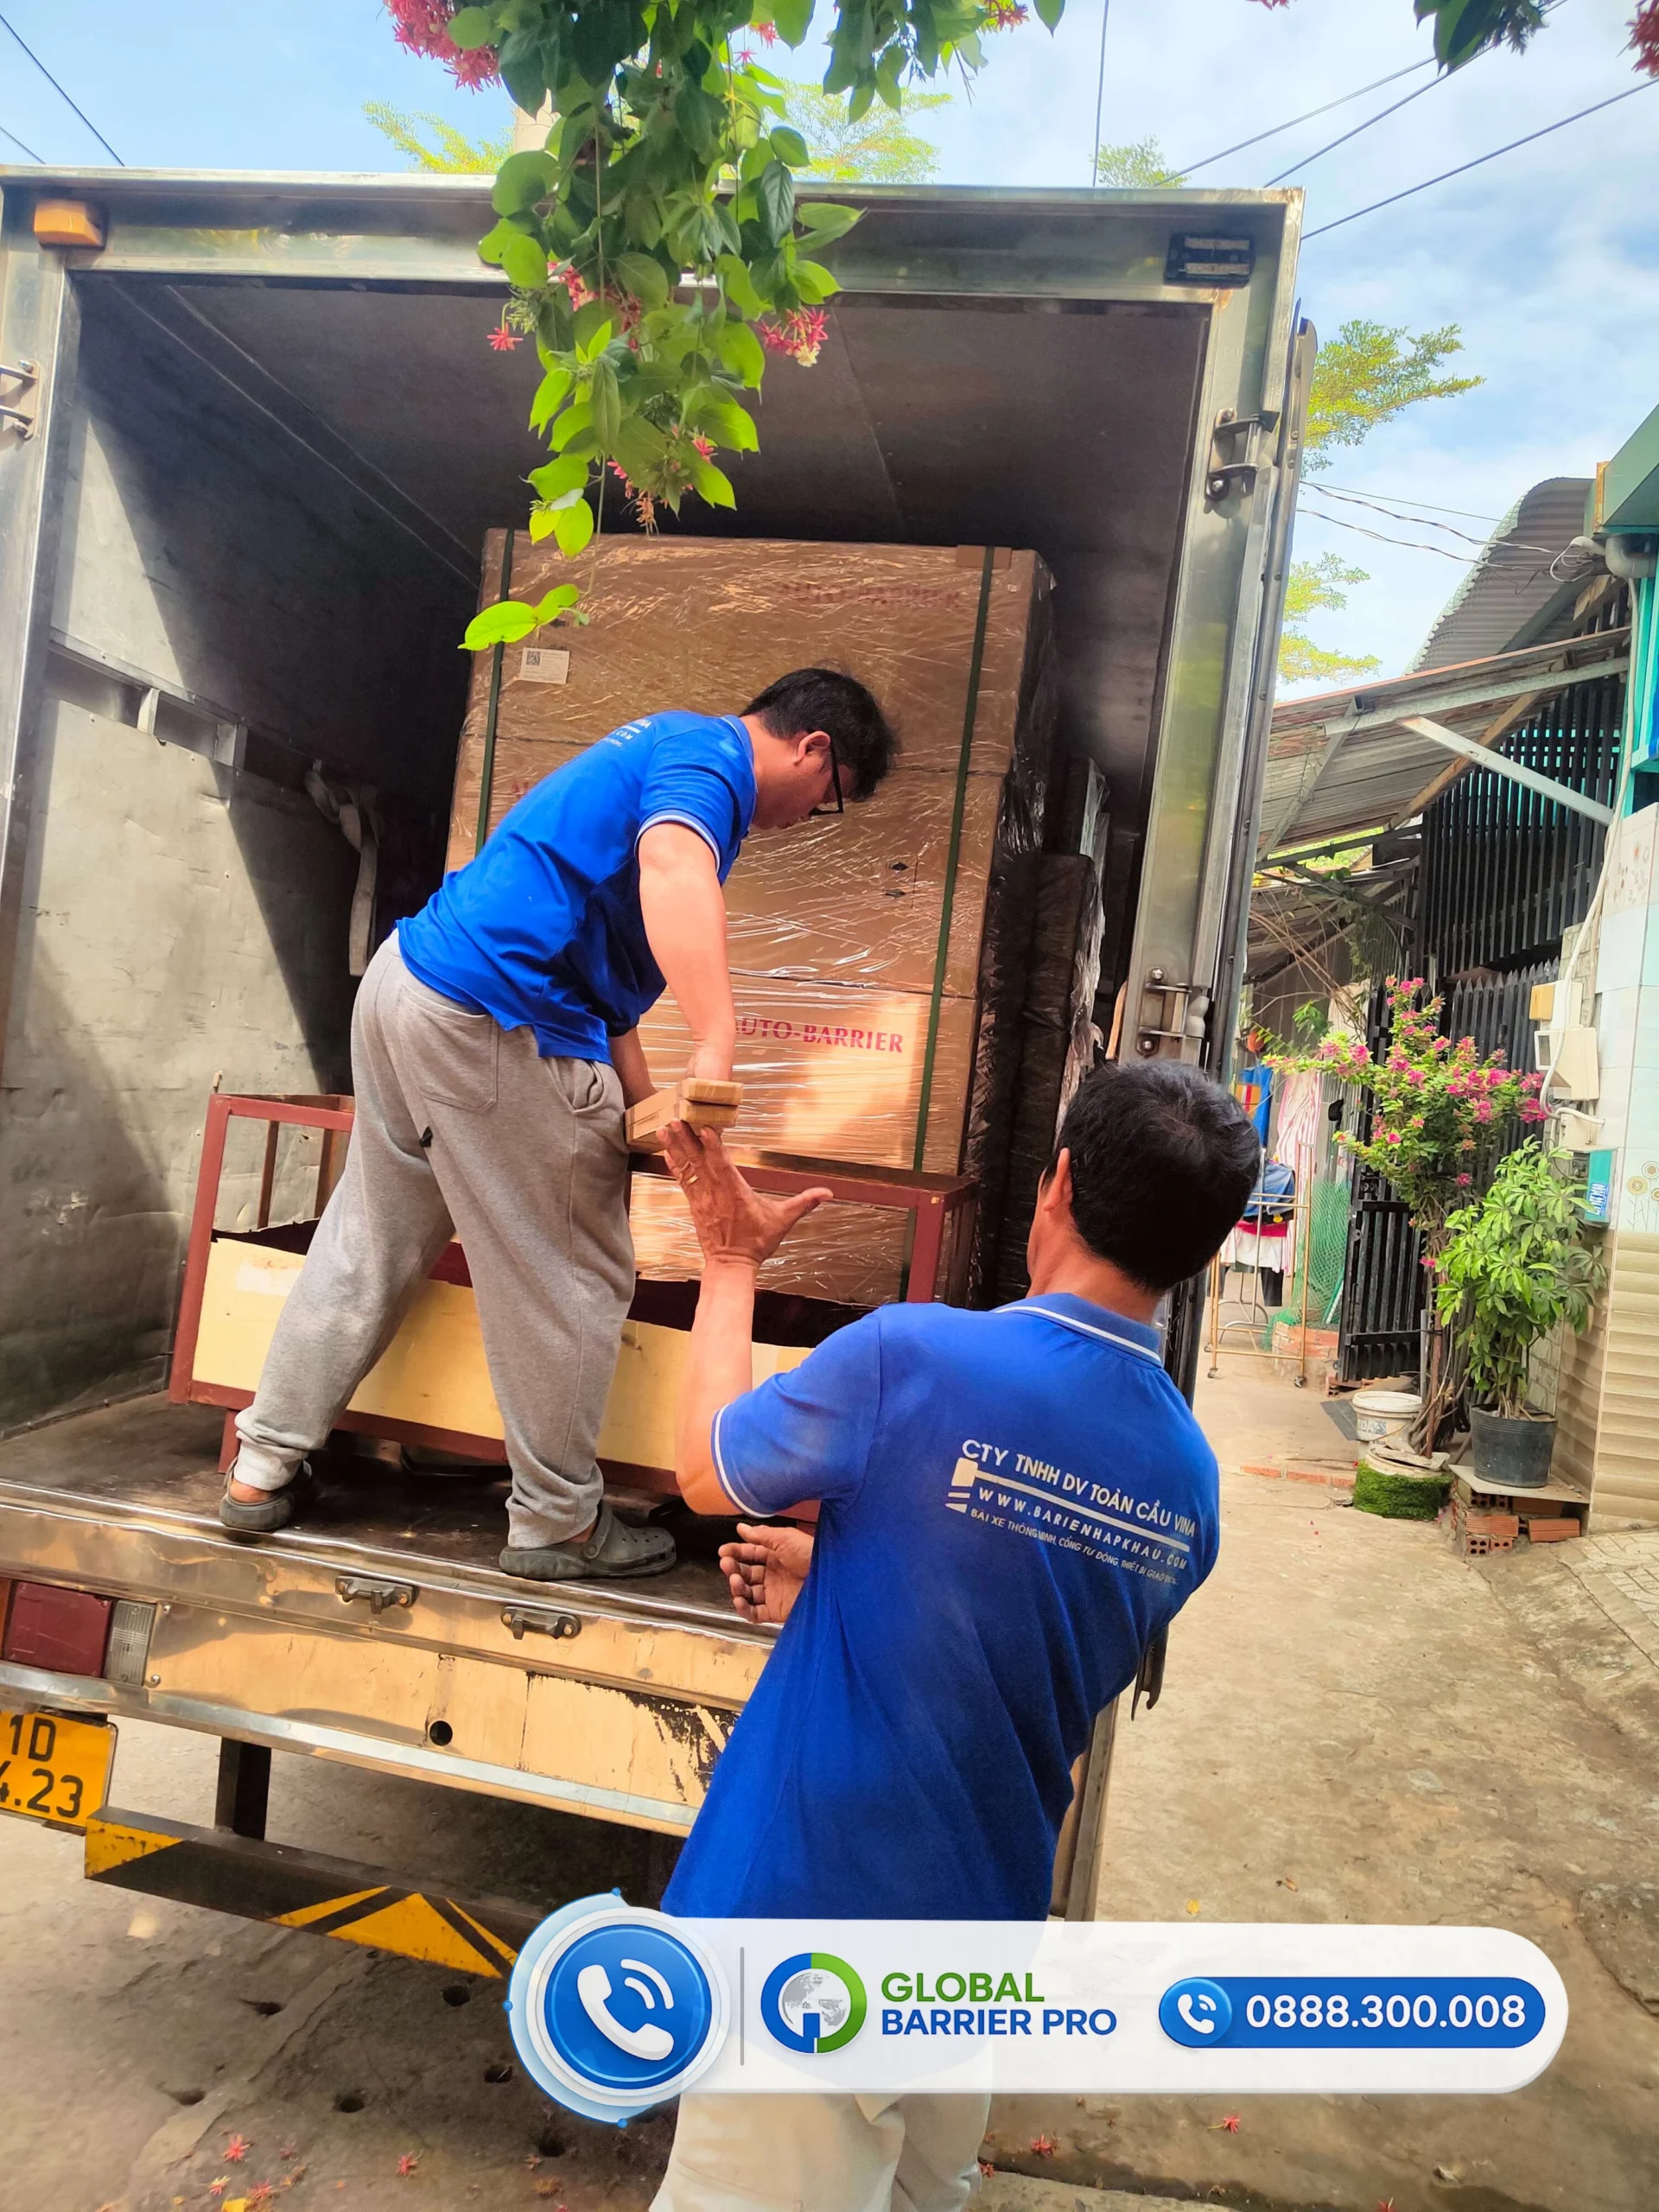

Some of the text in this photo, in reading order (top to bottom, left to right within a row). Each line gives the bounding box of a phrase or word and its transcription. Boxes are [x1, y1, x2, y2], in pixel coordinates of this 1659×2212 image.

[962, 1439, 1196, 1538] CTY TNHH DV TOÀN CẦU VINA
[990, 1515, 1007, 1528] XE
